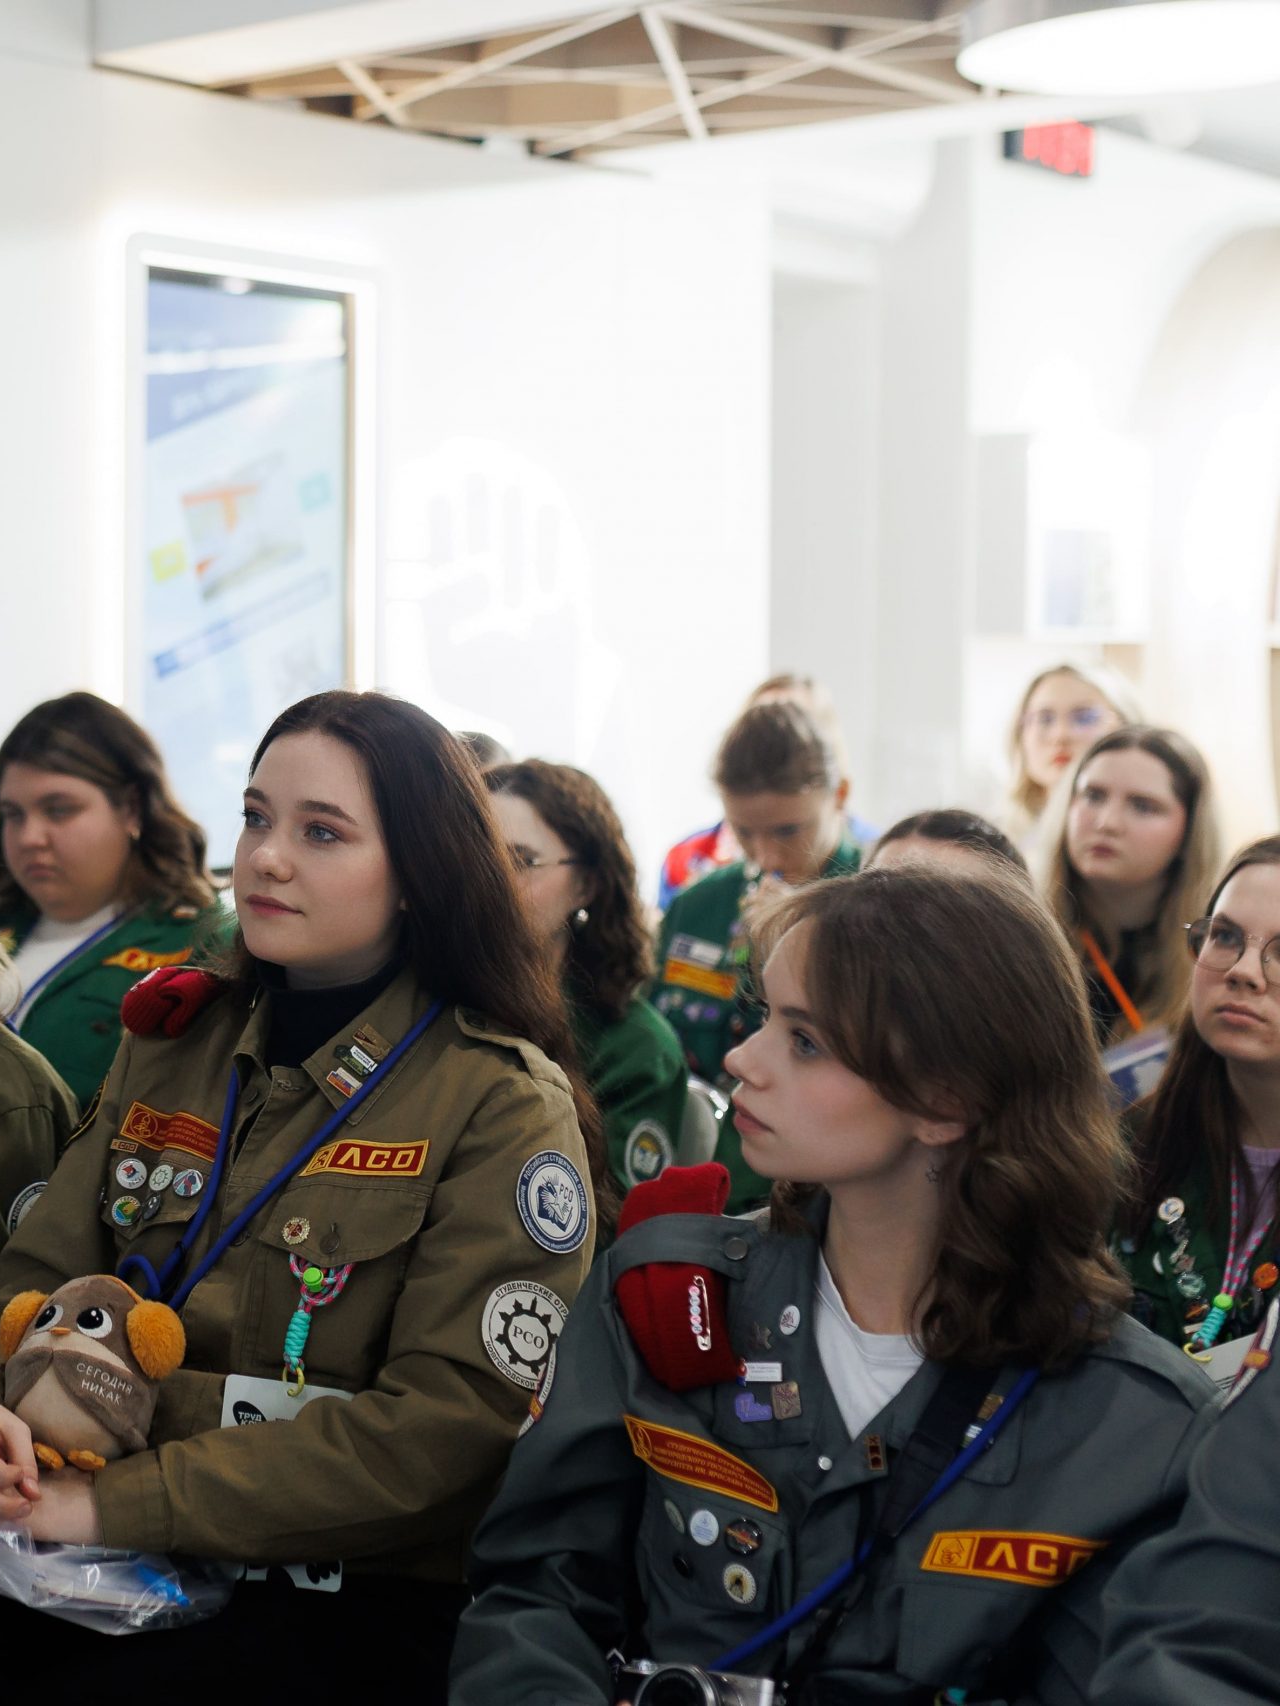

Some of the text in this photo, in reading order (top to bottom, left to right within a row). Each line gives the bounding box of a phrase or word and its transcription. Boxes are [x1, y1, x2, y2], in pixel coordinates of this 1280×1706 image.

[495, 1282, 554, 1301] СТУДЕНЧЕСКИЕ
[512, 1325, 544, 1349] РСО
[486, 1340, 535, 1388] НОВГОРОДСКОЙ
[76, 1362, 133, 1395] СЕГОДНЯ
[81, 1379, 122, 1405] НИКАК
[238, 1411, 262, 1422] ТРУД
